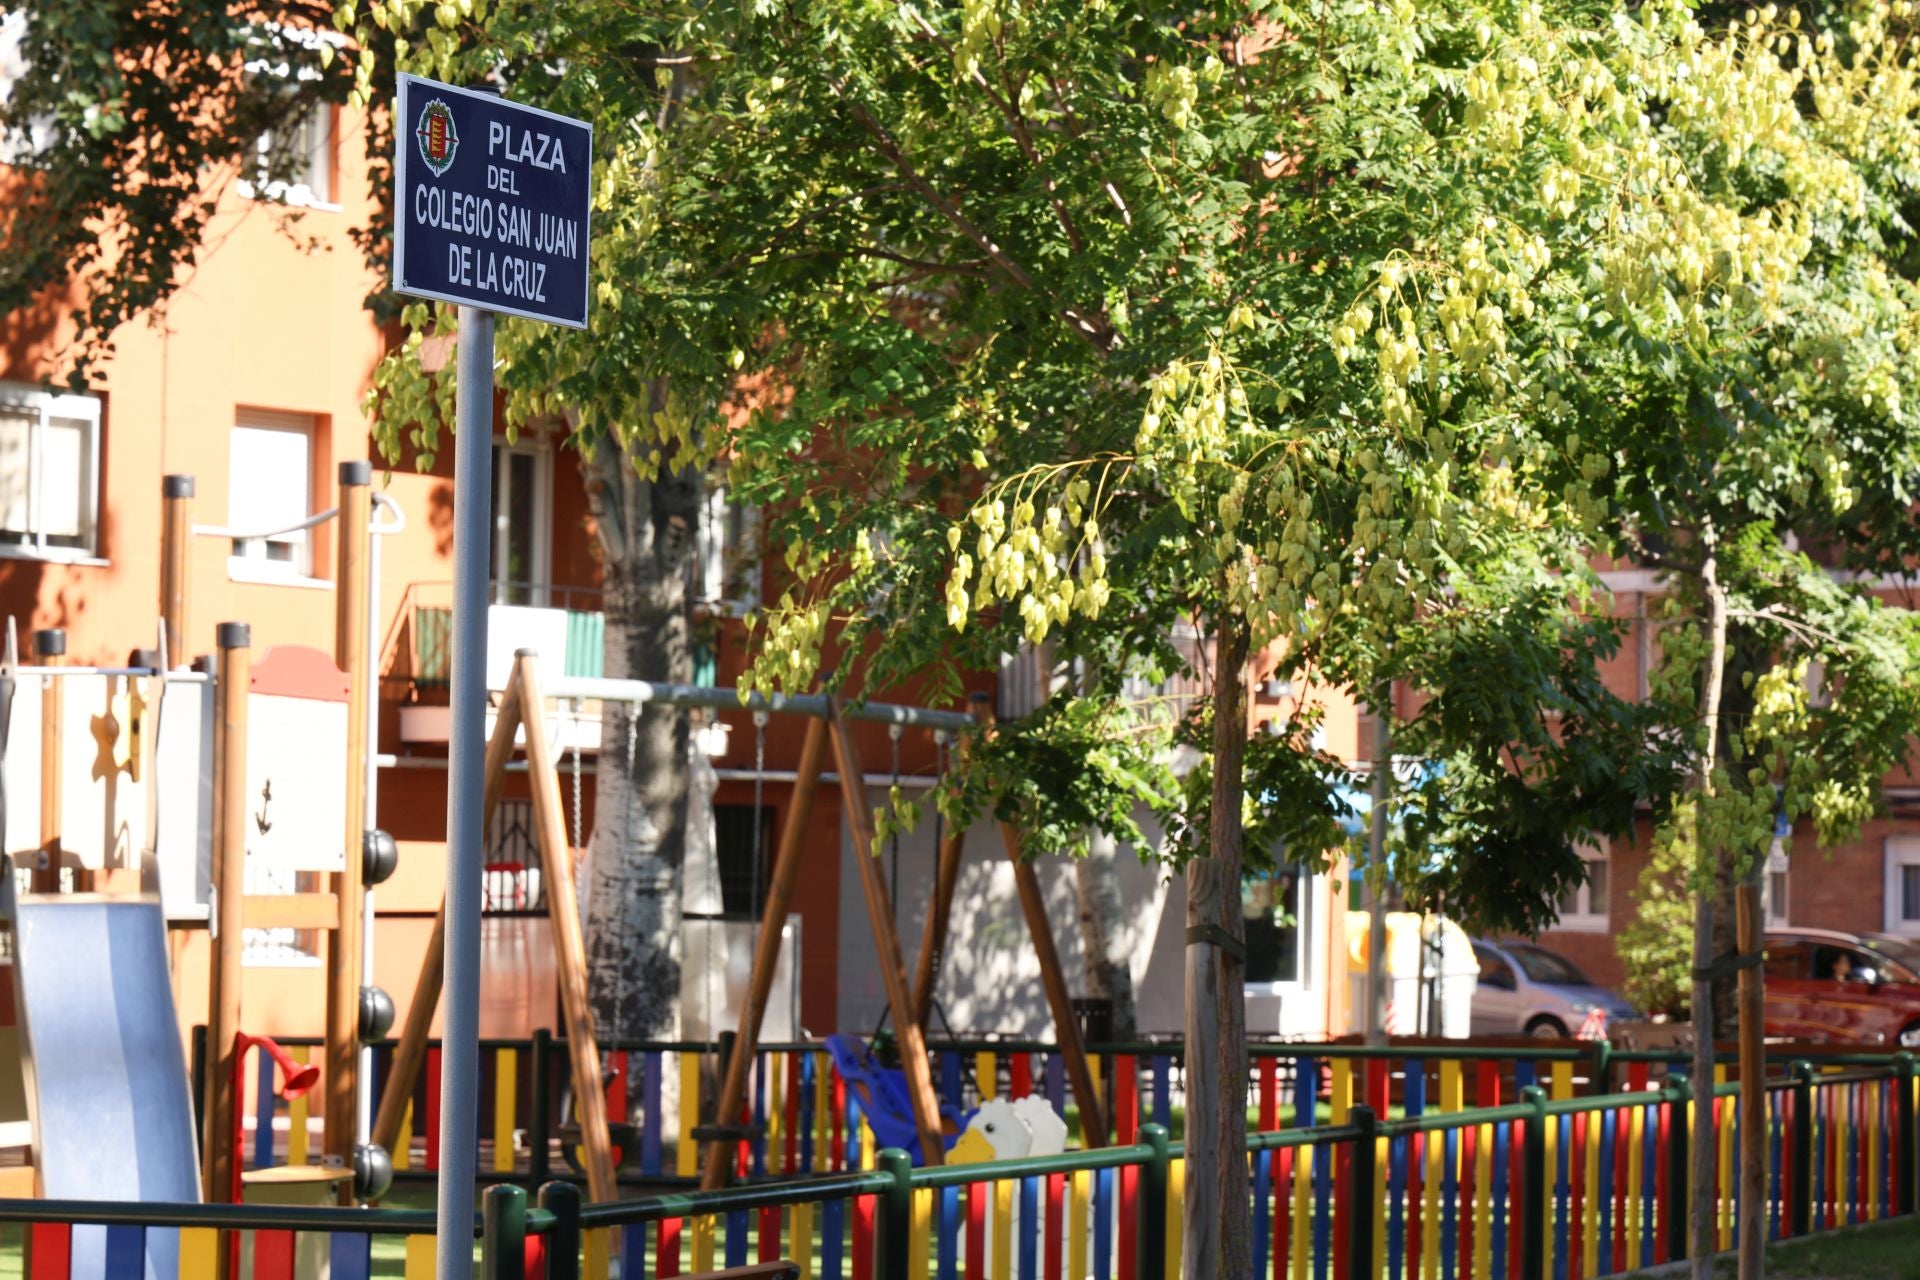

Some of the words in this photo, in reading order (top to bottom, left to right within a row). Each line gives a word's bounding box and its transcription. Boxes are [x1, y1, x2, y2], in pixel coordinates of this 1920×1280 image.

[488, 121, 566, 174] PLAZA
[487, 164, 520, 196] DEL
[415, 183, 493, 239] COLEGIO
[497, 202, 531, 248] SAN
[535, 213, 578, 259] JUAN
[448, 242, 472, 287] DE
[476, 249, 498, 292] LA
[502, 255, 546, 303] CRUZ
